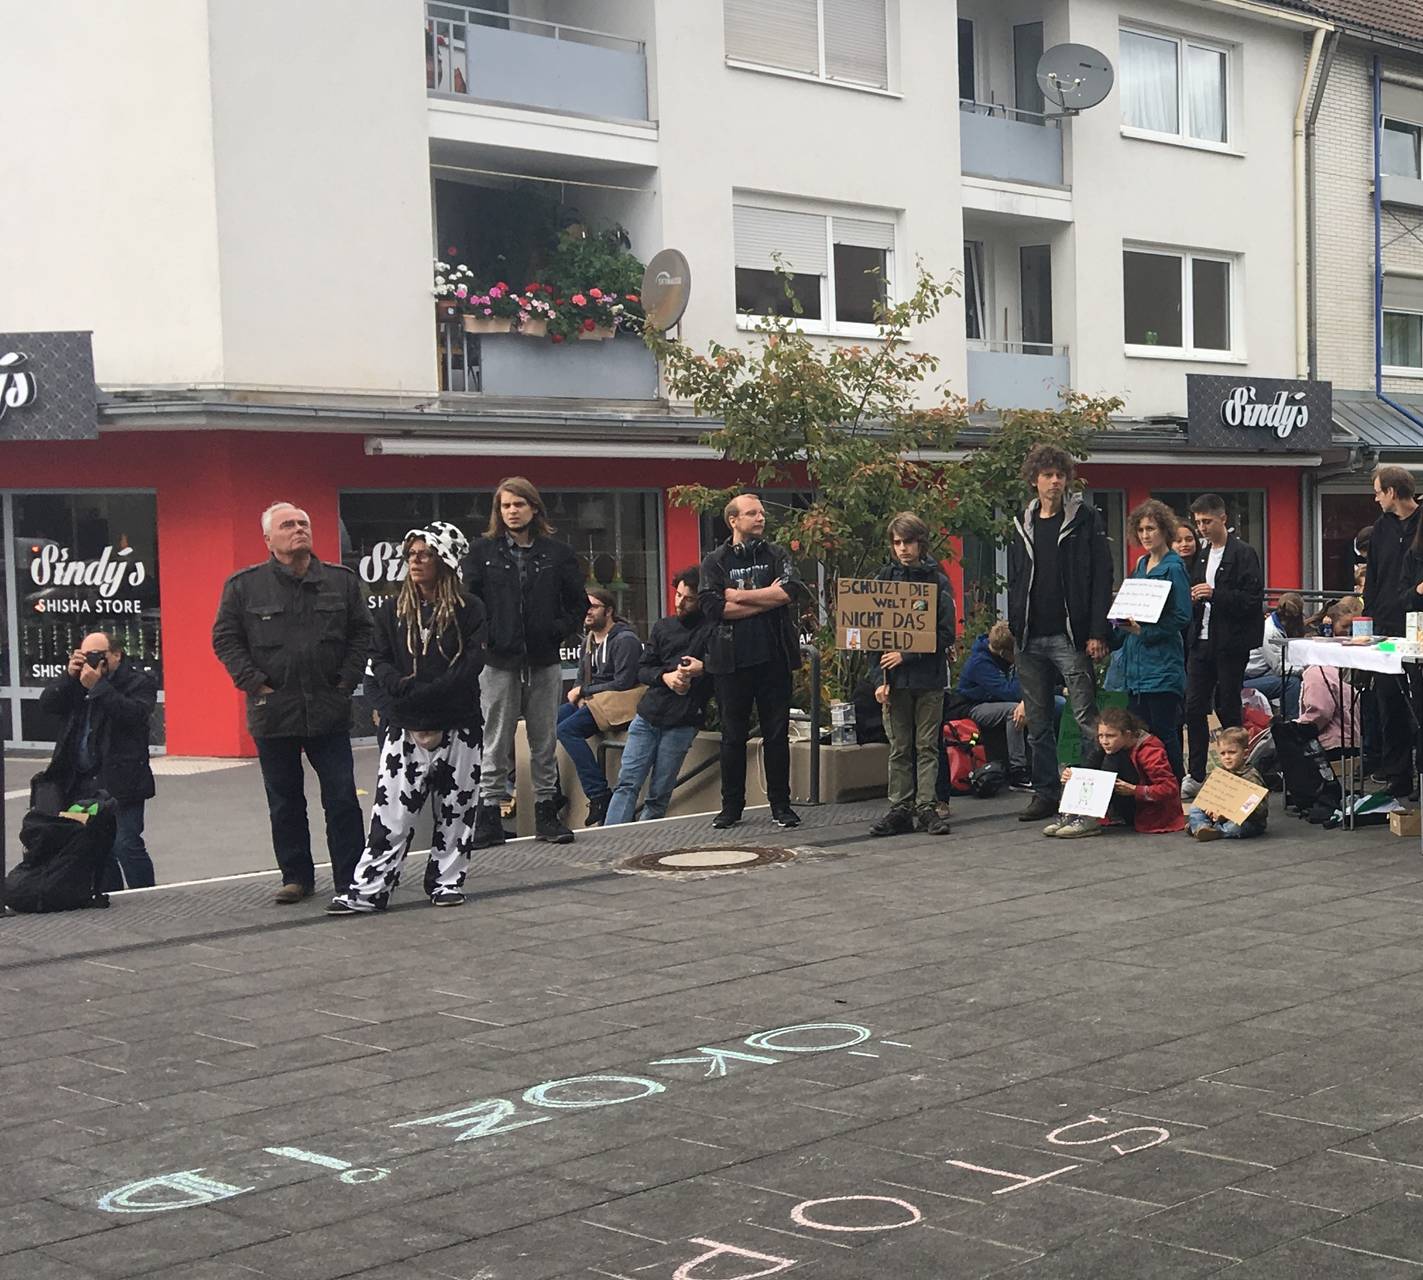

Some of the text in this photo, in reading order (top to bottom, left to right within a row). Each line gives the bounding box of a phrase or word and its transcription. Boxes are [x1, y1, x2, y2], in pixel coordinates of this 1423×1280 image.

[909, 583, 929, 597] DIE
[35, 598, 141, 613] SHISHA STORE
[873, 598, 907, 609] WELT
[842, 611, 926, 631] NICHT DAS
[867, 630, 913, 650] GELD
[672, 1113, 1170, 1280] STOP
